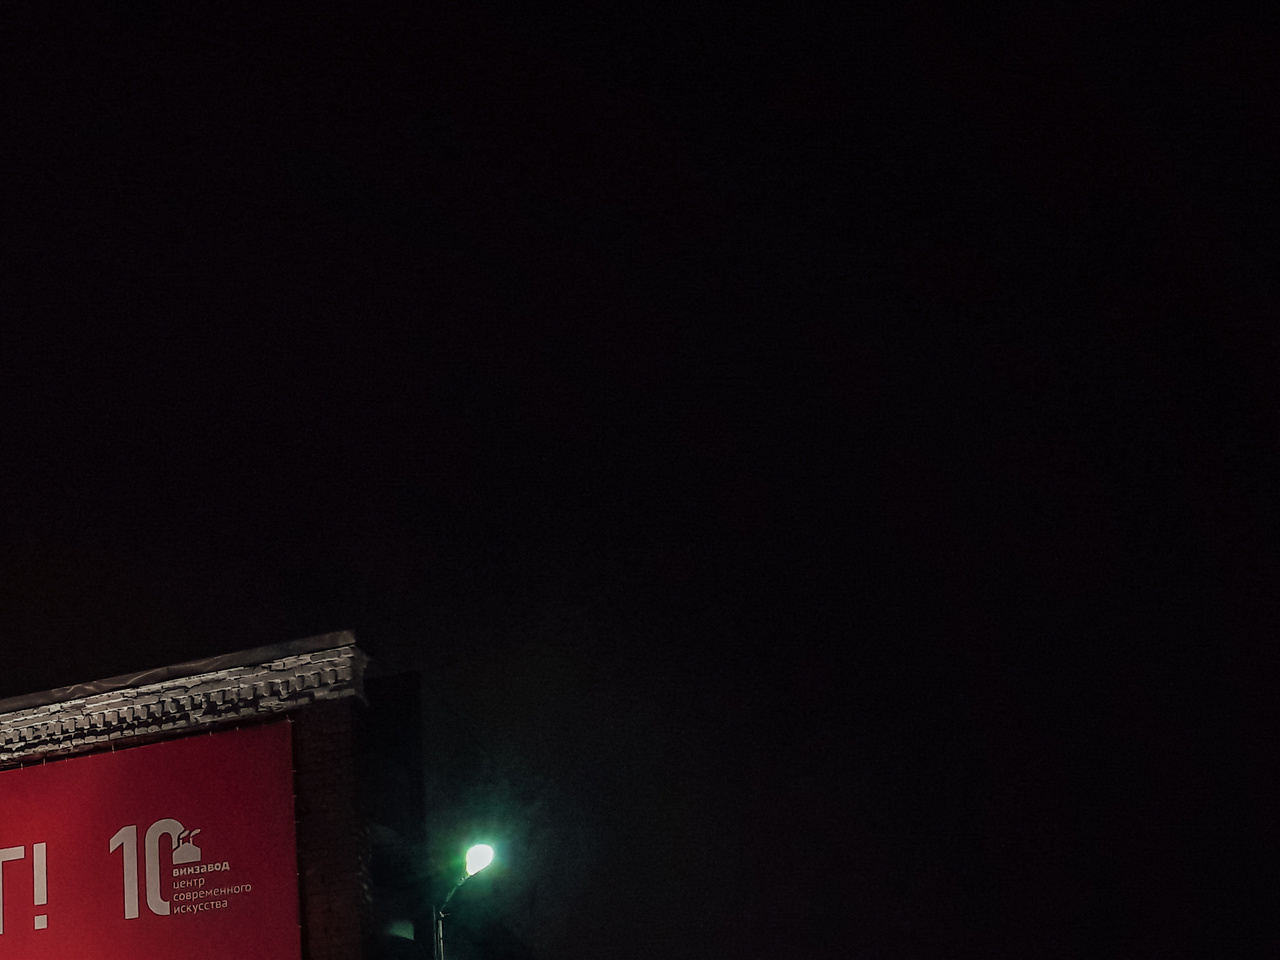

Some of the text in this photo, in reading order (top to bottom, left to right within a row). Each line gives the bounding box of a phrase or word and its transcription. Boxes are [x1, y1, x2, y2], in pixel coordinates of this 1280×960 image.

[172, 861, 231, 877] винзавод
[173, 877, 206, 890] центр
[173, 883, 252, 902] современного
[173, 899, 228, 915] искусства
